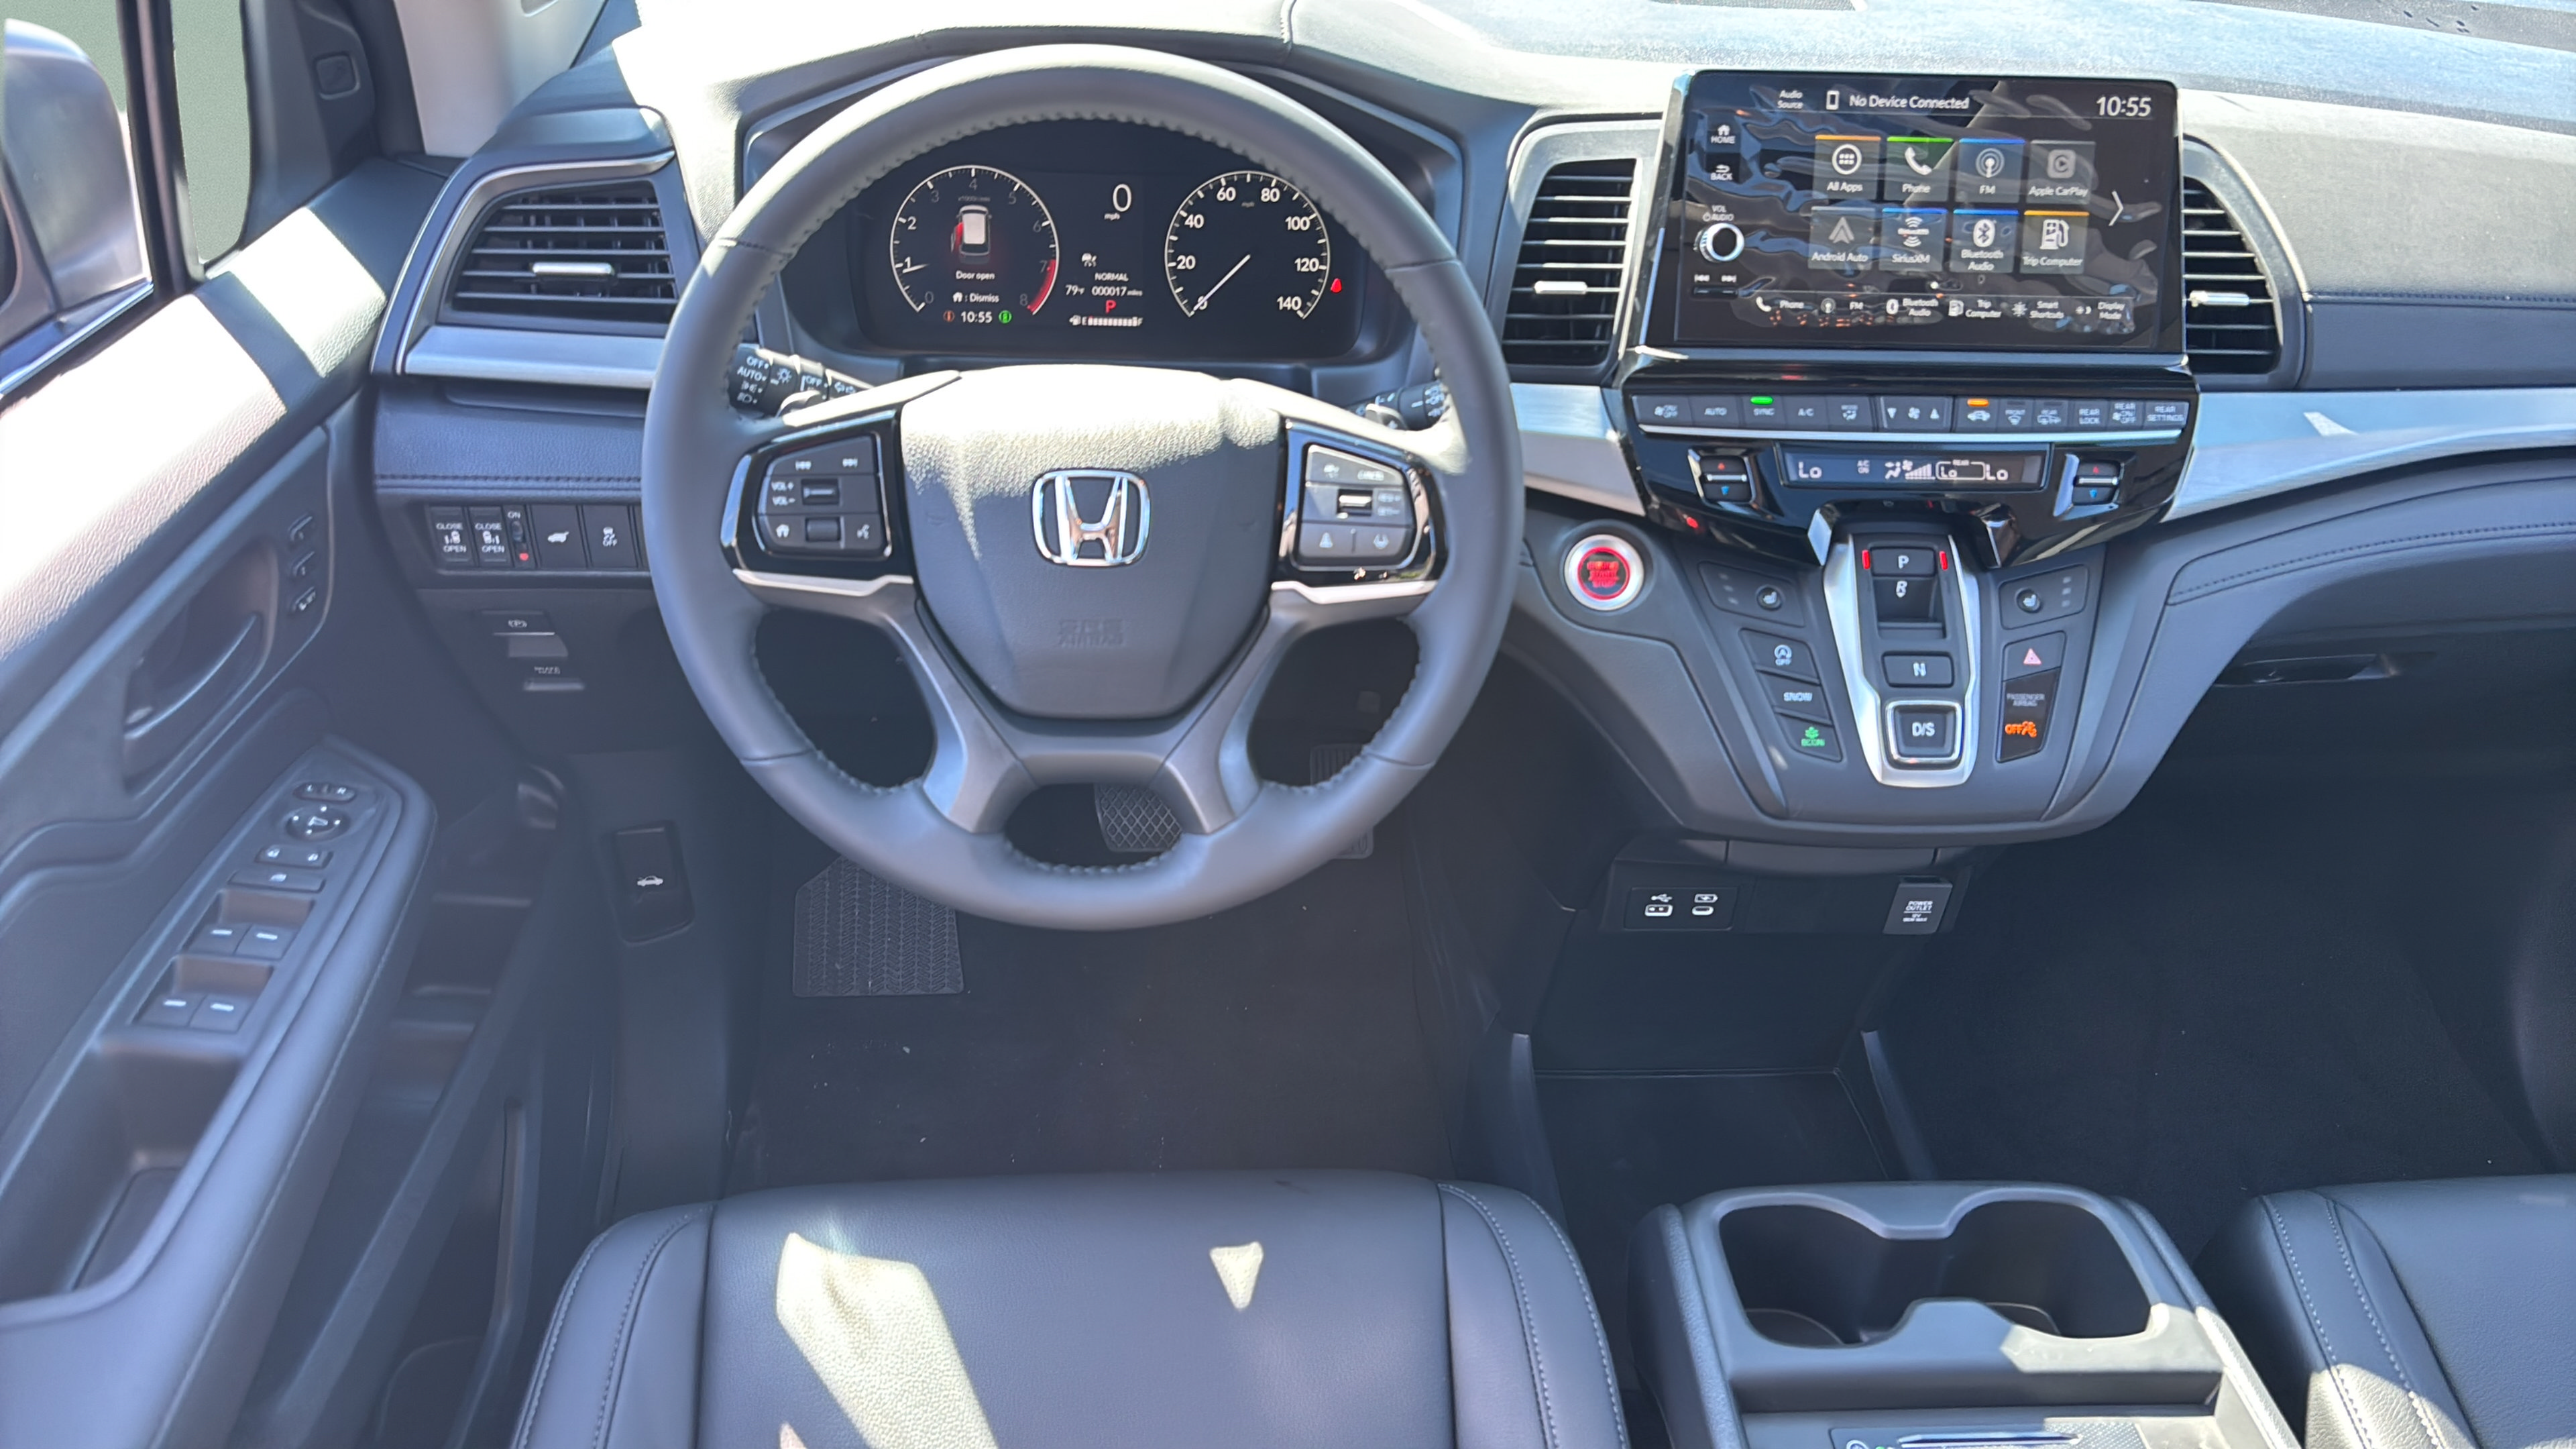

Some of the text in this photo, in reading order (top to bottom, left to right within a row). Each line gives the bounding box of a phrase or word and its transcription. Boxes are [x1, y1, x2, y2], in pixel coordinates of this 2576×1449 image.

[1779, 91, 1803, 100] Audio
[1777, 101, 1803, 110] Source
[1850, 95, 1969, 110] No Device Connected
[2096, 97, 2152, 117] 10:55
[1711, 136, 1736, 144] HOME
[1710, 172, 1732, 181] BACK
[969, 178, 977, 191] 4
[1827, 182, 1863, 193] All Apps
[1902, 184, 1931, 193] Phone
[1217, 186, 1236, 201] 60
[1261, 188, 1280, 203] 80
[1980, 186, 1995, 195] FM
[2029, 186, 2089, 198] Apple CarPlay
[931, 191, 939, 202] 3
[1009, 193, 1016, 205] 5
[1113, 184, 1132, 212] 0
[1105, 213, 1120, 221] mph
[1184, 214, 1205, 229] 40
[1712, 213, 1734, 221] AUDIO
[907, 217, 917, 230] 2
[1033, 221, 1042, 233] 6
[1285, 216, 1310, 231] 100
[1811, 252, 1868, 262] Android Auto
[1892, 254, 1930, 264] SiriusXM
[1961, 250, 2004, 259] Bluetooth
[905, 257, 911, 269] 1
[1040, 260, 1048, 273] 7
[1176, 255, 1196, 270] 20
[1294, 258, 1320, 272] 120
[1968, 262, 1995, 271] Audio
[2023, 256, 2083, 268] Trip Computer
[956, 271, 995, 280] Door open
[1095, 273, 1129, 282] NORMAL
[1091, 286, 1127, 297] 000017
[925, 291, 934, 304] 0
[970, 294, 999, 303] Dismiss
[1020, 294, 1027, 306] 8
[1903, 298, 1939, 307] Bluetooth
[1105, 300, 1117, 314] P
[1277, 297, 1302, 311] 140
[1779, 301, 1804, 309] Phone
[1849, 302, 1864, 310] FM
[1977, 300, 1992, 309] Trip
[2036, 301, 2059, 310] Smart
[2097, 302, 2125, 312] Display
[961, 311, 993, 323] 10:55
[1909, 309, 1931, 317] Audio
[1965, 309, 2002, 319] Computer
[2029, 311, 2064, 319] Shortcuts
[2099, 311, 2122, 320] Mode
[746, 356, 764, 368] OFF
[737, 366, 763, 381] AUTO
[805, 375, 822, 387] OFF
[1704, 407, 1727, 416] AUTO
[1753, 408, 1775, 417] SYNC
[2147, 414, 2184, 422] SETTINGS
[1798, 462, 1822, 478] Lo
[1940, 466, 1958, 478] Lo
[1985, 464, 2009, 480] Lo
[508, 511, 520, 519] ON
[443, 545, 467, 553] OPEN
[482, 545, 504, 553] OPEN
[1898, 555, 1909, 569] P
[1896, 581, 1907, 593] R
[1913, 662, 1927, 676] N
[1783, 692, 1813, 702] SNOW
[1912, 722, 1935, 737] D/S
[2005, 724, 2023, 735] OFF
